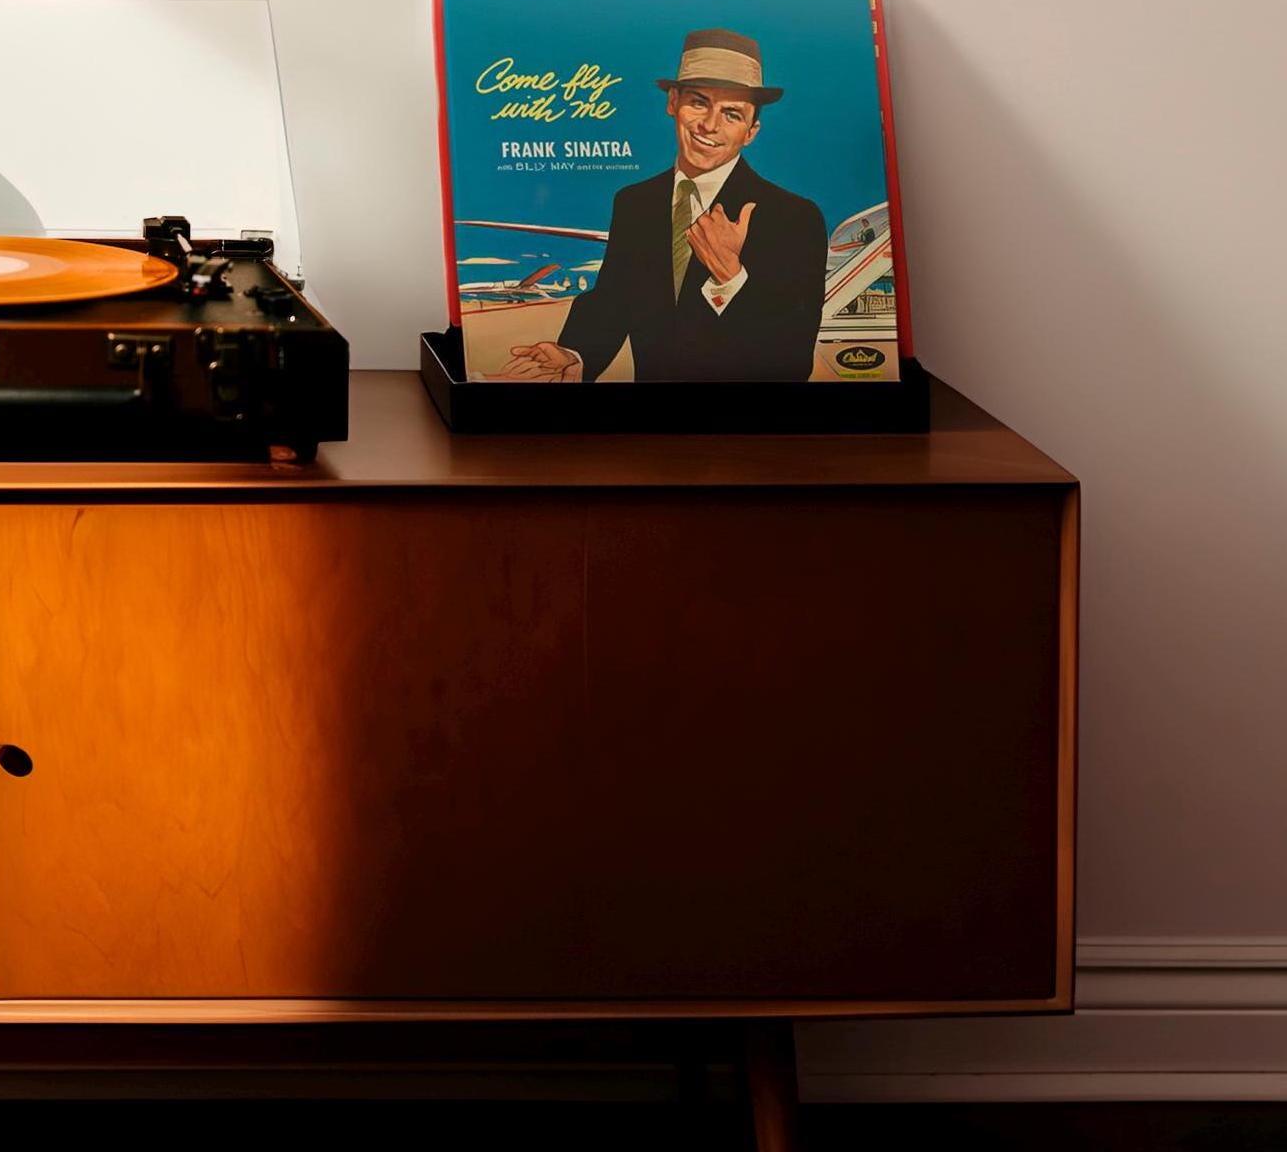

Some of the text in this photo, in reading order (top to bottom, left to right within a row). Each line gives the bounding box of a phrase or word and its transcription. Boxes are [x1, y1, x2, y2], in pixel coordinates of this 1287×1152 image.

[475, 57, 623, 103] Come fly
[490, 94, 617, 123] with me
[501, 141, 633, 158] FRANK SINATRA
[550, 162, 575, 171] MAY
